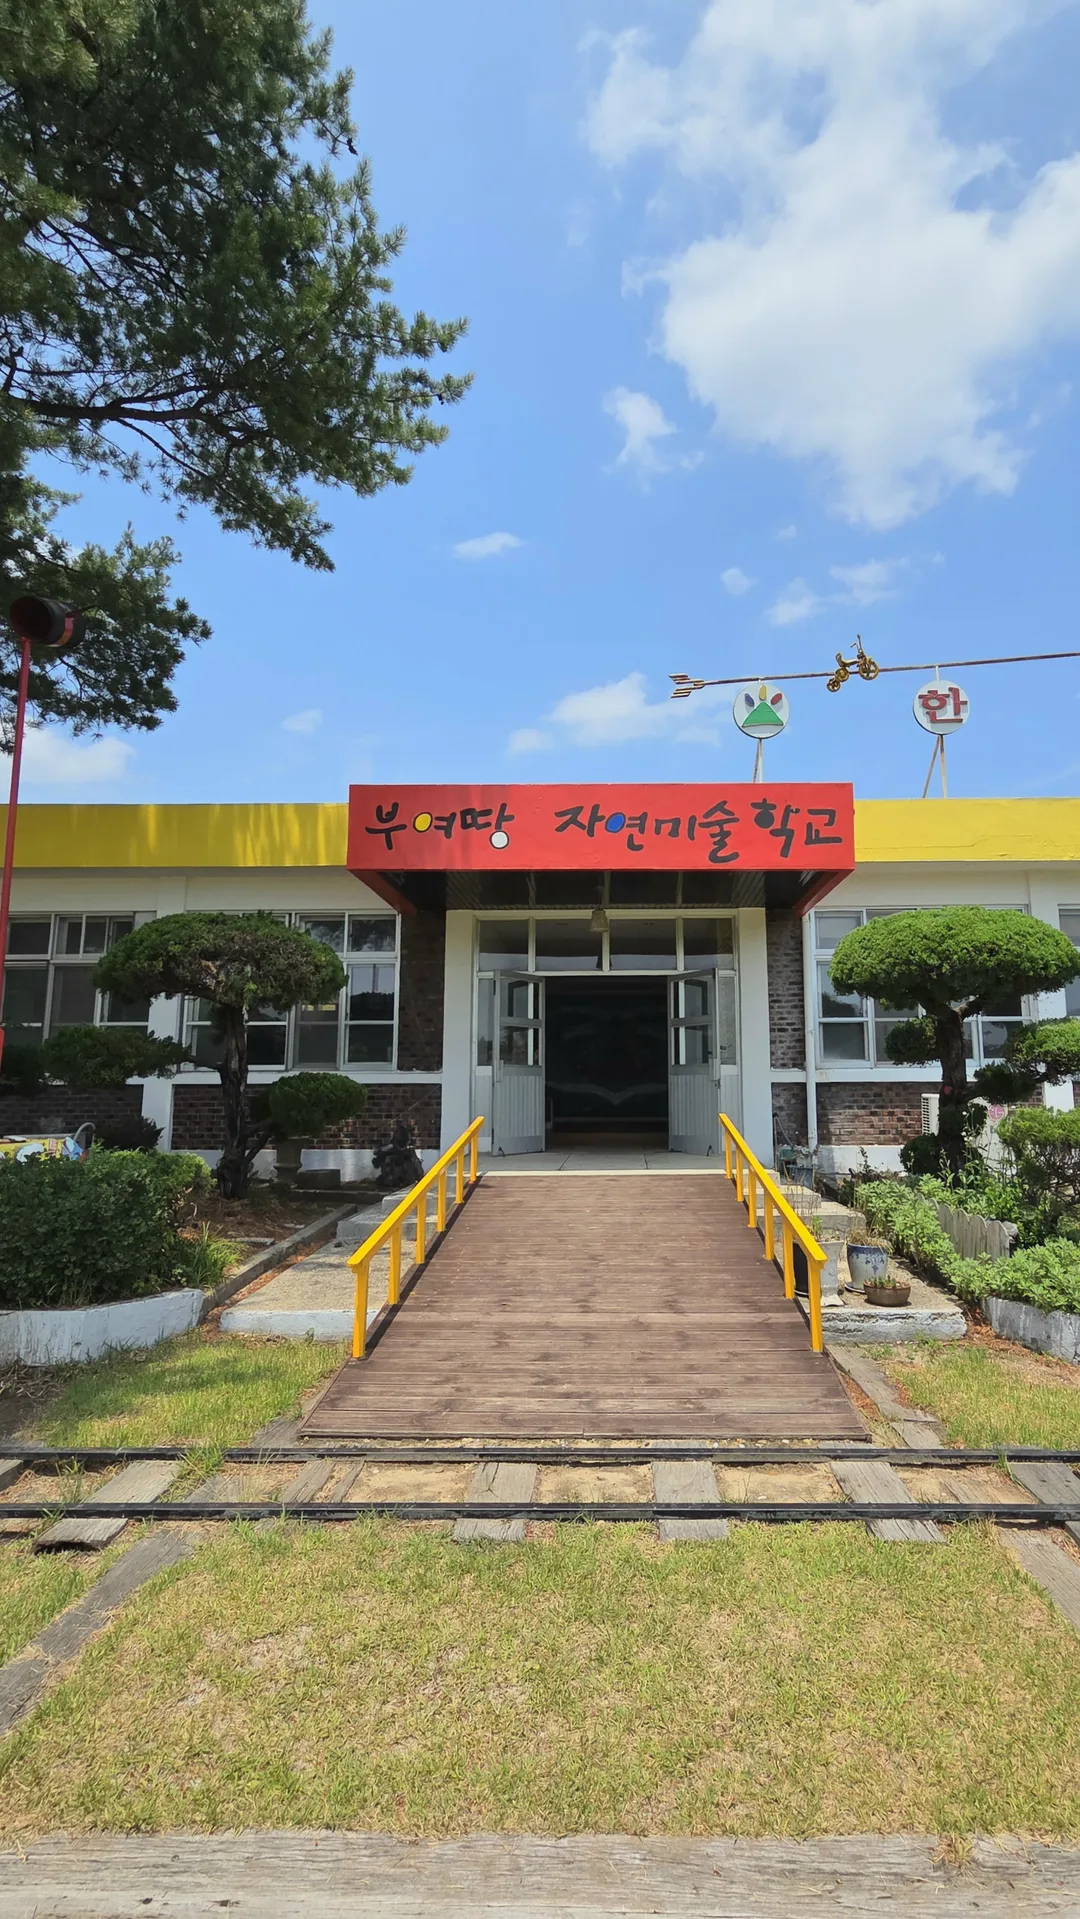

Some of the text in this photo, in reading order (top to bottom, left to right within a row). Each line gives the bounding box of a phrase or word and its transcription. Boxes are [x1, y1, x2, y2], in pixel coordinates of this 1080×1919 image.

[917, 686, 968, 724] 한
[365, 797, 843, 864] 부여땅 자연미술학교
